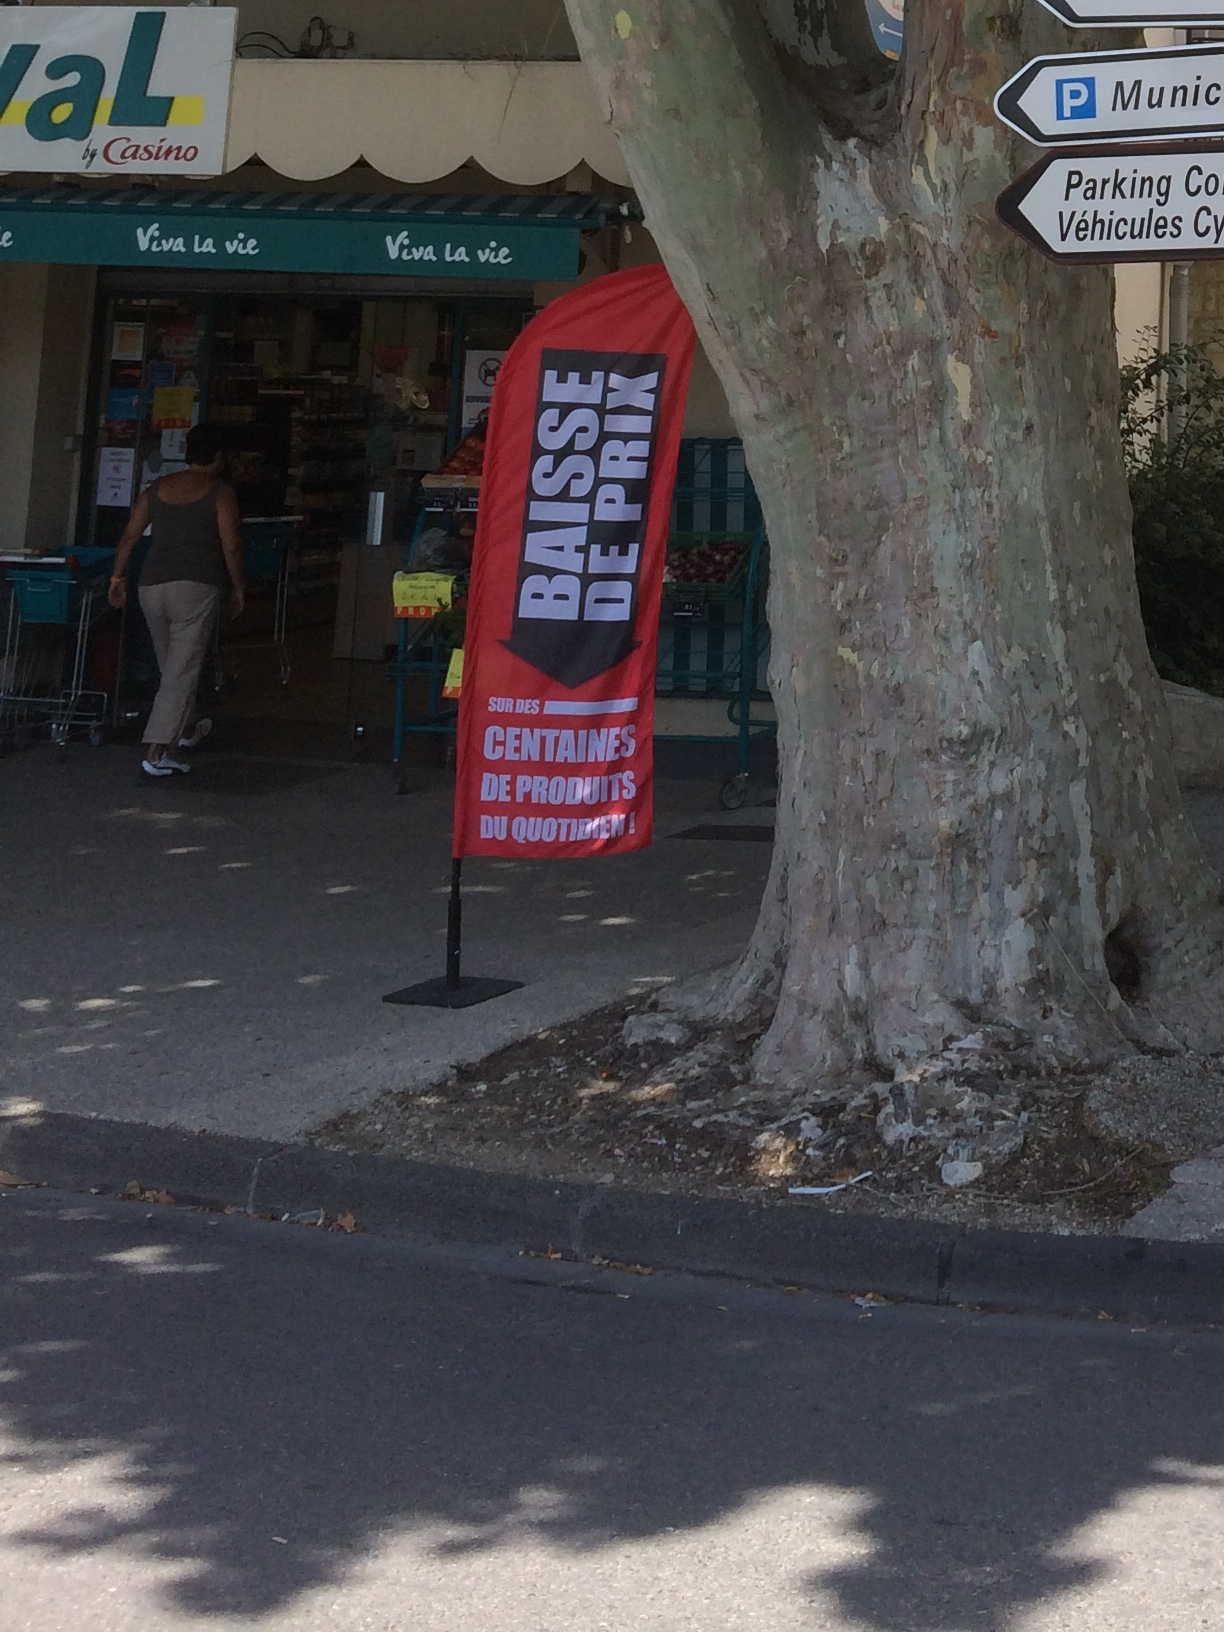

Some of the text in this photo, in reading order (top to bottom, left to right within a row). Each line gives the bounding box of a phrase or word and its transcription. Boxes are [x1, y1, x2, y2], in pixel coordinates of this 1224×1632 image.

[1062, 82, 1089, 118] P
[82, 136, 199, 169] by Casino
[1064, 168, 1172, 206] Parking
[137, 223, 187, 253] Viva
[225, 232, 260, 255] vie
[1058, 207, 1183, 242] Véhicules
[385, 230, 438, 262] Viva
[477, 240, 513, 264] vie
[518, 370, 604, 621] BAISSE
[584, 371, 659, 622] DE PRIX
[488, 696, 541, 715] SUR DES
[483, 723, 636, 763] CENTAINES
[480, 770, 636, 805] DE PRODUITS
[480, 814, 508, 841] DU
[511, 813, 626, 844] QUOTIDIEN
